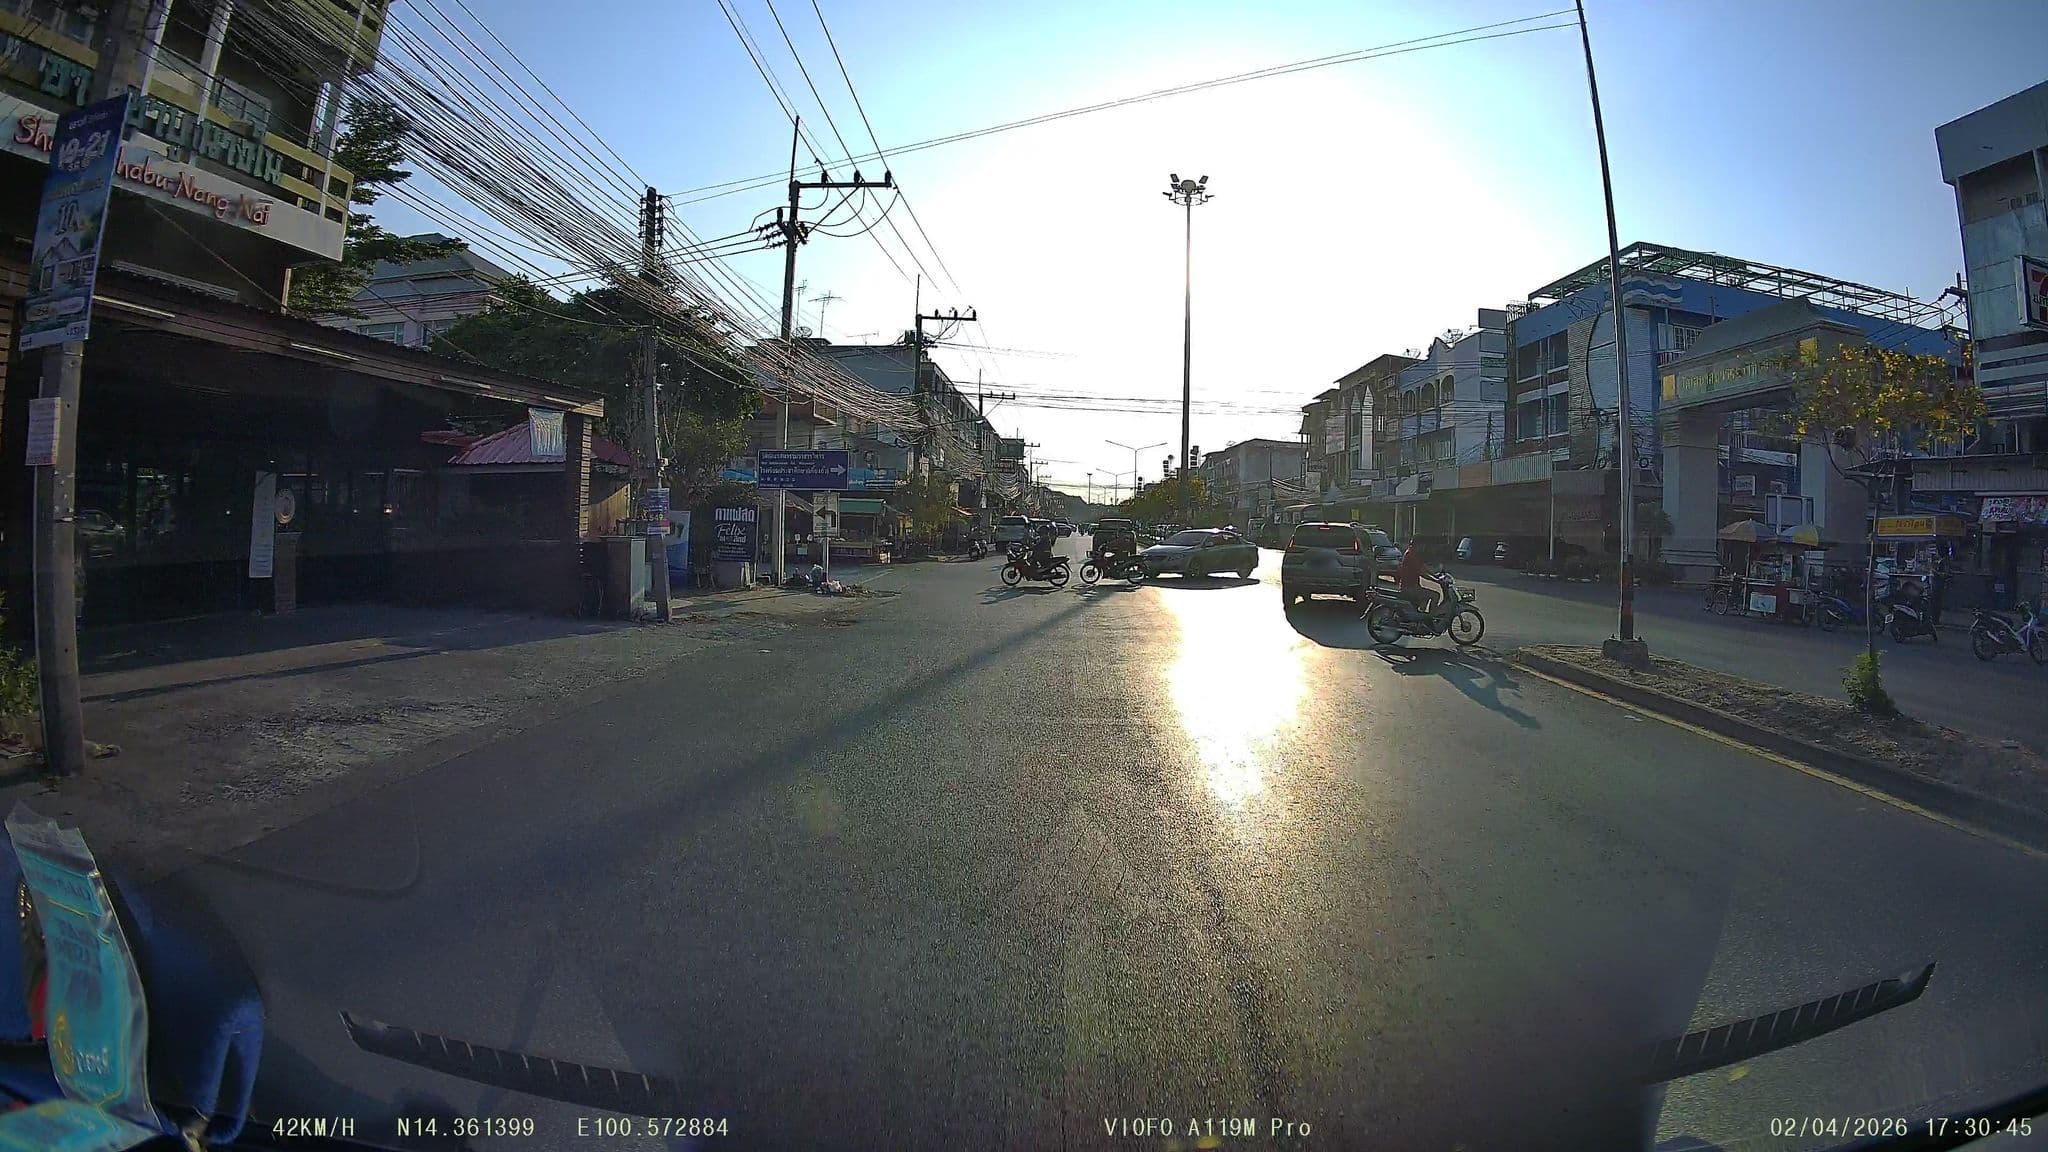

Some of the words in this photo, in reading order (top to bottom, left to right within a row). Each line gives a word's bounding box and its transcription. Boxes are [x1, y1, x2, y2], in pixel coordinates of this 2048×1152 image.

[15, 115, 54, 152] Sh
[116, 146, 171, 190] habu
[173, 171, 231, 219] Nang
[715, 506, 755, 522] กาแฟสด
[714, 522, 746, 538] Felix
